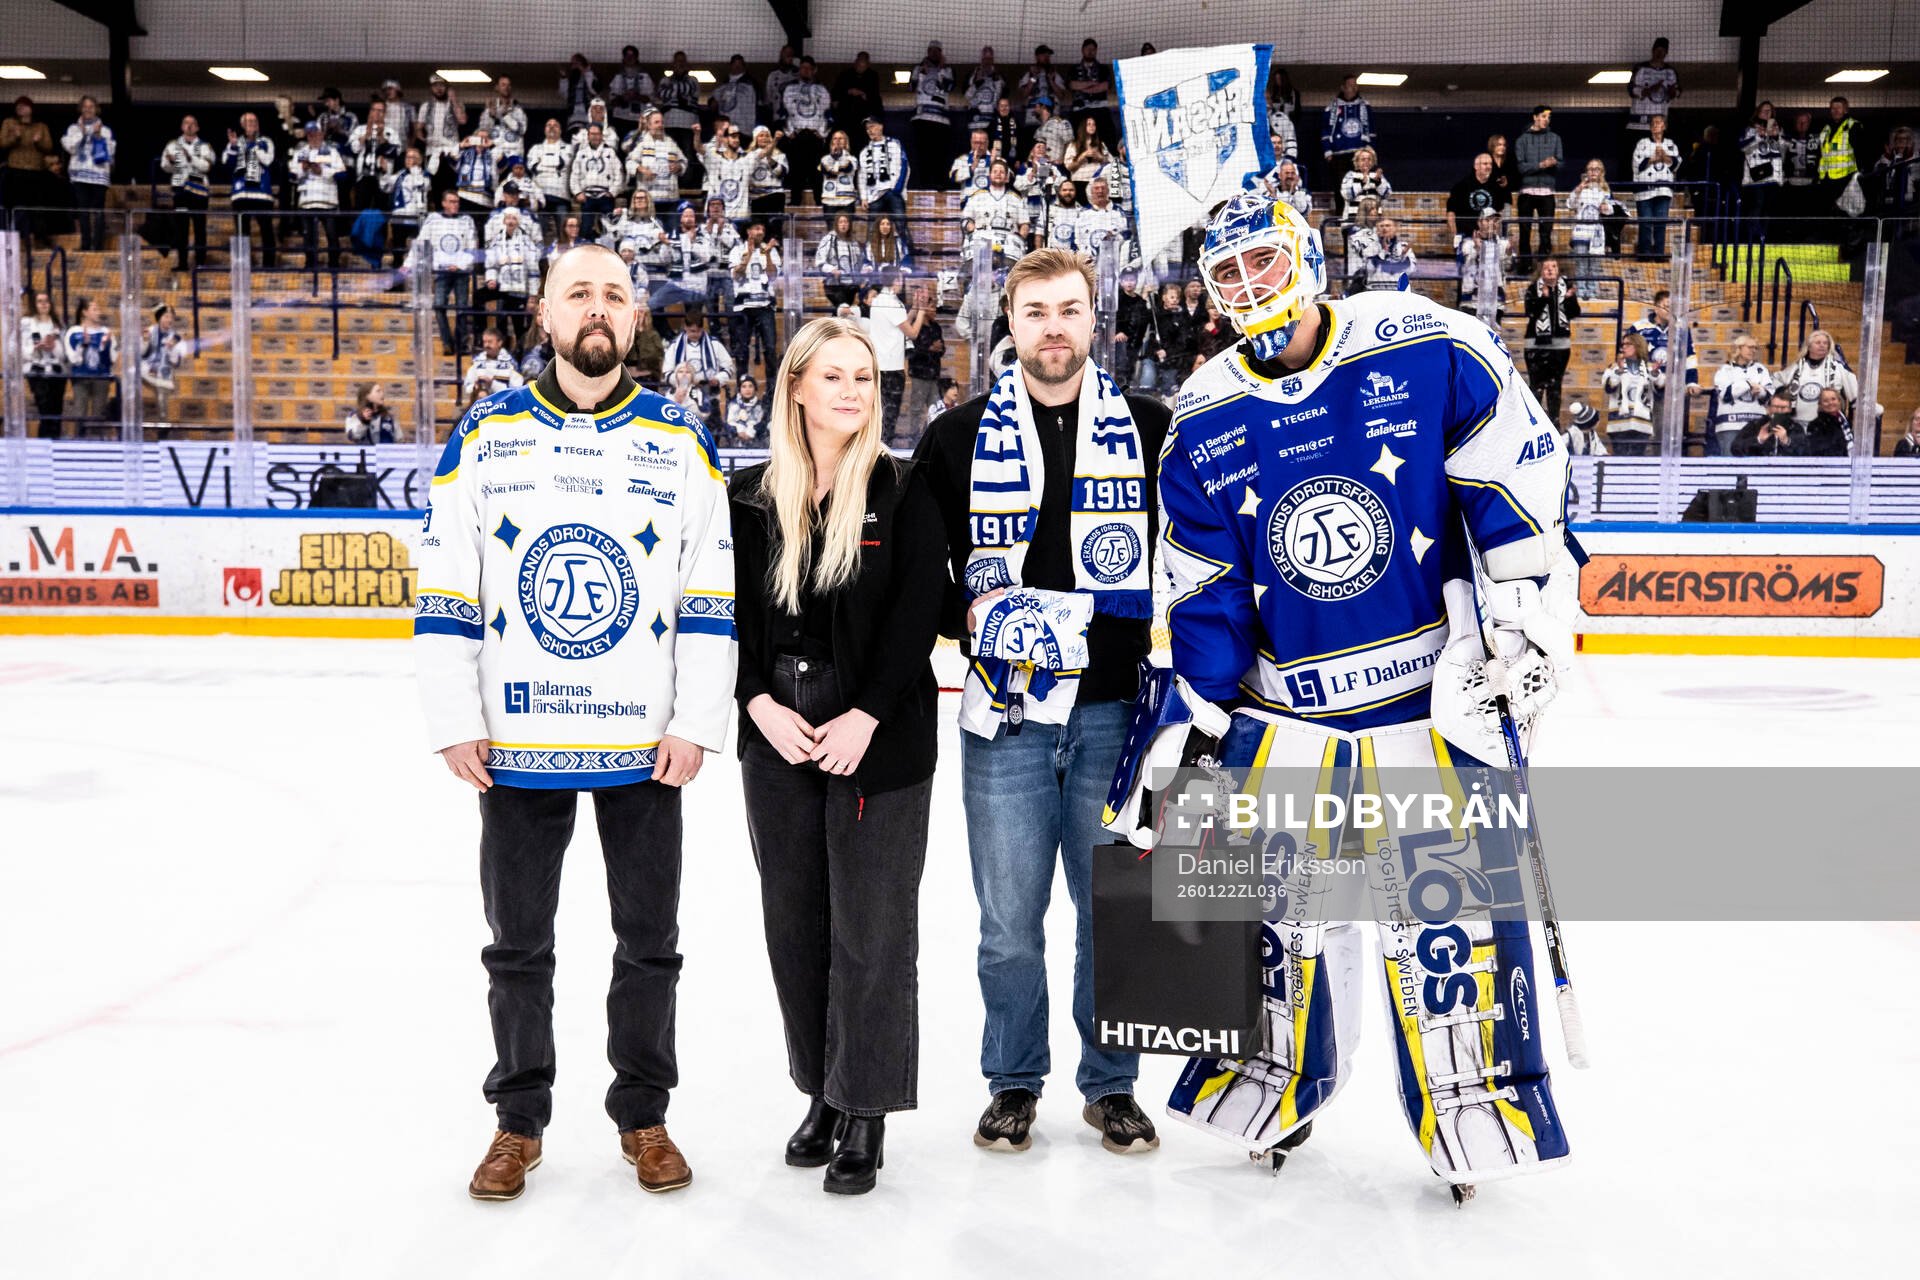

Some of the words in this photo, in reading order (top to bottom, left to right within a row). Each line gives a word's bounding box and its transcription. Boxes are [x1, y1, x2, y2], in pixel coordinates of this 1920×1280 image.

[1402, 313, 1432, 324] Clas
[1403, 321, 1448, 334] Ohlson
[1336, 320, 1354, 350] TEGERA
[1226, 361, 1246, 384] TEGERA
[1178, 391, 1194, 402] las
[1281, 381, 1302, 397] 50
[1362, 392, 1410, 407] LEKSANDS
[537, 409, 560, 427] TEGERA
[607, 411, 632, 426] TEGERA
[1282, 406, 1328, 426] TEGERA
[1205, 424, 1248, 449] Bergkvist
[1366, 419, 1418, 438] dalakraft
[493, 449, 518, 459] Siljan
[494, 438, 537, 449] Bergkvist
[564, 446, 603, 457] TEGERA
[1210, 442, 1235, 458] Siljan
[1516, 431, 1555, 465] AEB
[627, 454, 678, 467] LEKSANDS
[168, 447, 231, 508] Vi
[508, 483, 536, 493] HEDIN
[554, 474, 603, 487] GRÖNSAKS
[1203, 462, 1259, 498] Helmans
[566, 485, 597, 495] HUSET
[627, 485, 677, 501] dalakraft
[1083, 480, 1141, 510] 1919
[1271, 502, 1298, 582] LEKSANDS
[1289, 480, 1390, 556] IDROTTSFÖRENING
[300, 532, 393, 570] EURO
[112, 582, 150, 601] AB
[270, 568, 418, 608] JACKPOT
[520, 538, 549, 625] LEKSANDS
[1307, 564, 1379, 598] ISHOCKEY
[1597, 563, 1864, 602] ÅKERSTRÖMS
[540, 632, 614, 657] ISHOCKEY
[1330, 671, 1359, 695] LF
[1363, 644, 1446, 687] Dalarna
[533, 680, 593, 697] Dalarnas
[532, 699, 647, 720] Försäkringsbolag
[1376, 838, 1405, 933] LOGISTICS
[1395, 948, 1418, 1017] SWEDEN
[1398, 829, 1480, 1017] LOGS
[1290, 932, 1304, 1010] LOGISTICS
[1513, 967, 1531, 1041] REACTOR
[1101, 1020, 1239, 1054] HITACHI
